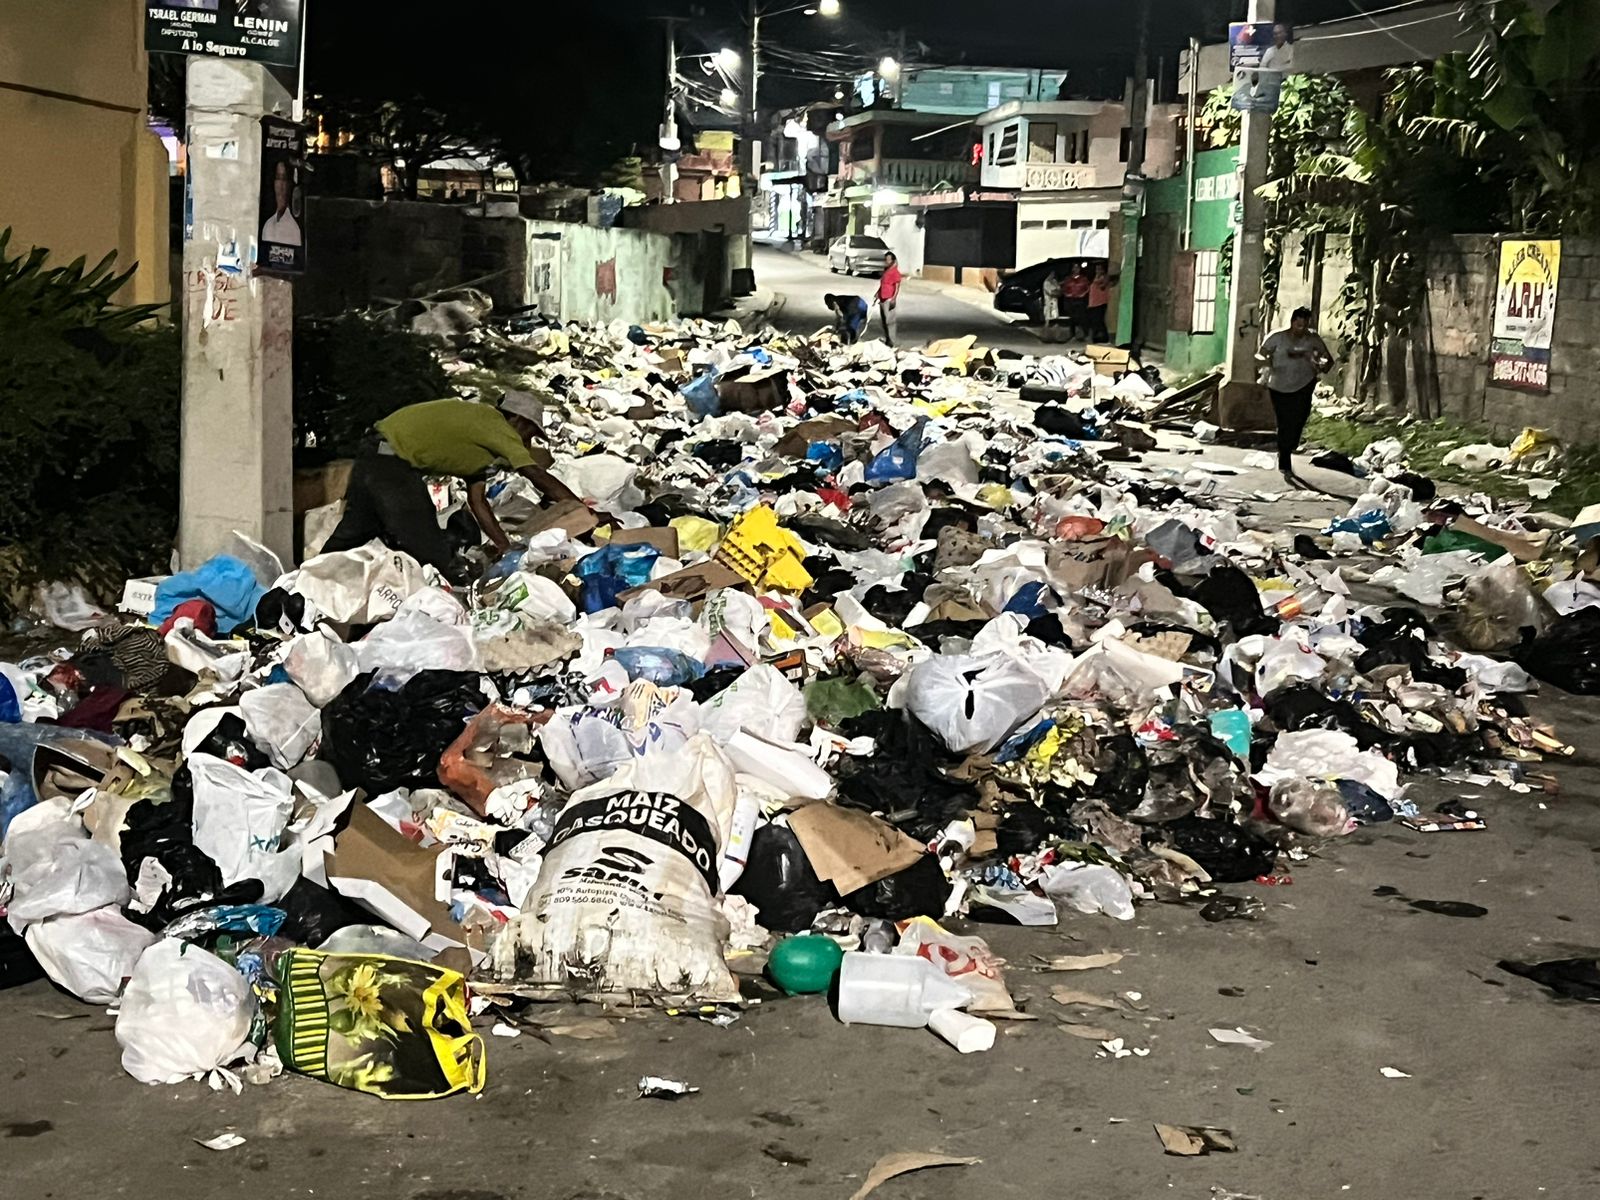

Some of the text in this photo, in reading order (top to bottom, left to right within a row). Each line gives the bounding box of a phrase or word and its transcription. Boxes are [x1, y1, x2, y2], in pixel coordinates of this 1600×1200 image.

[233, 16, 289, 33] LENIN
[181, 39, 247, 56] A lo Seguro
[240, 36, 280, 47] ALCALDE
